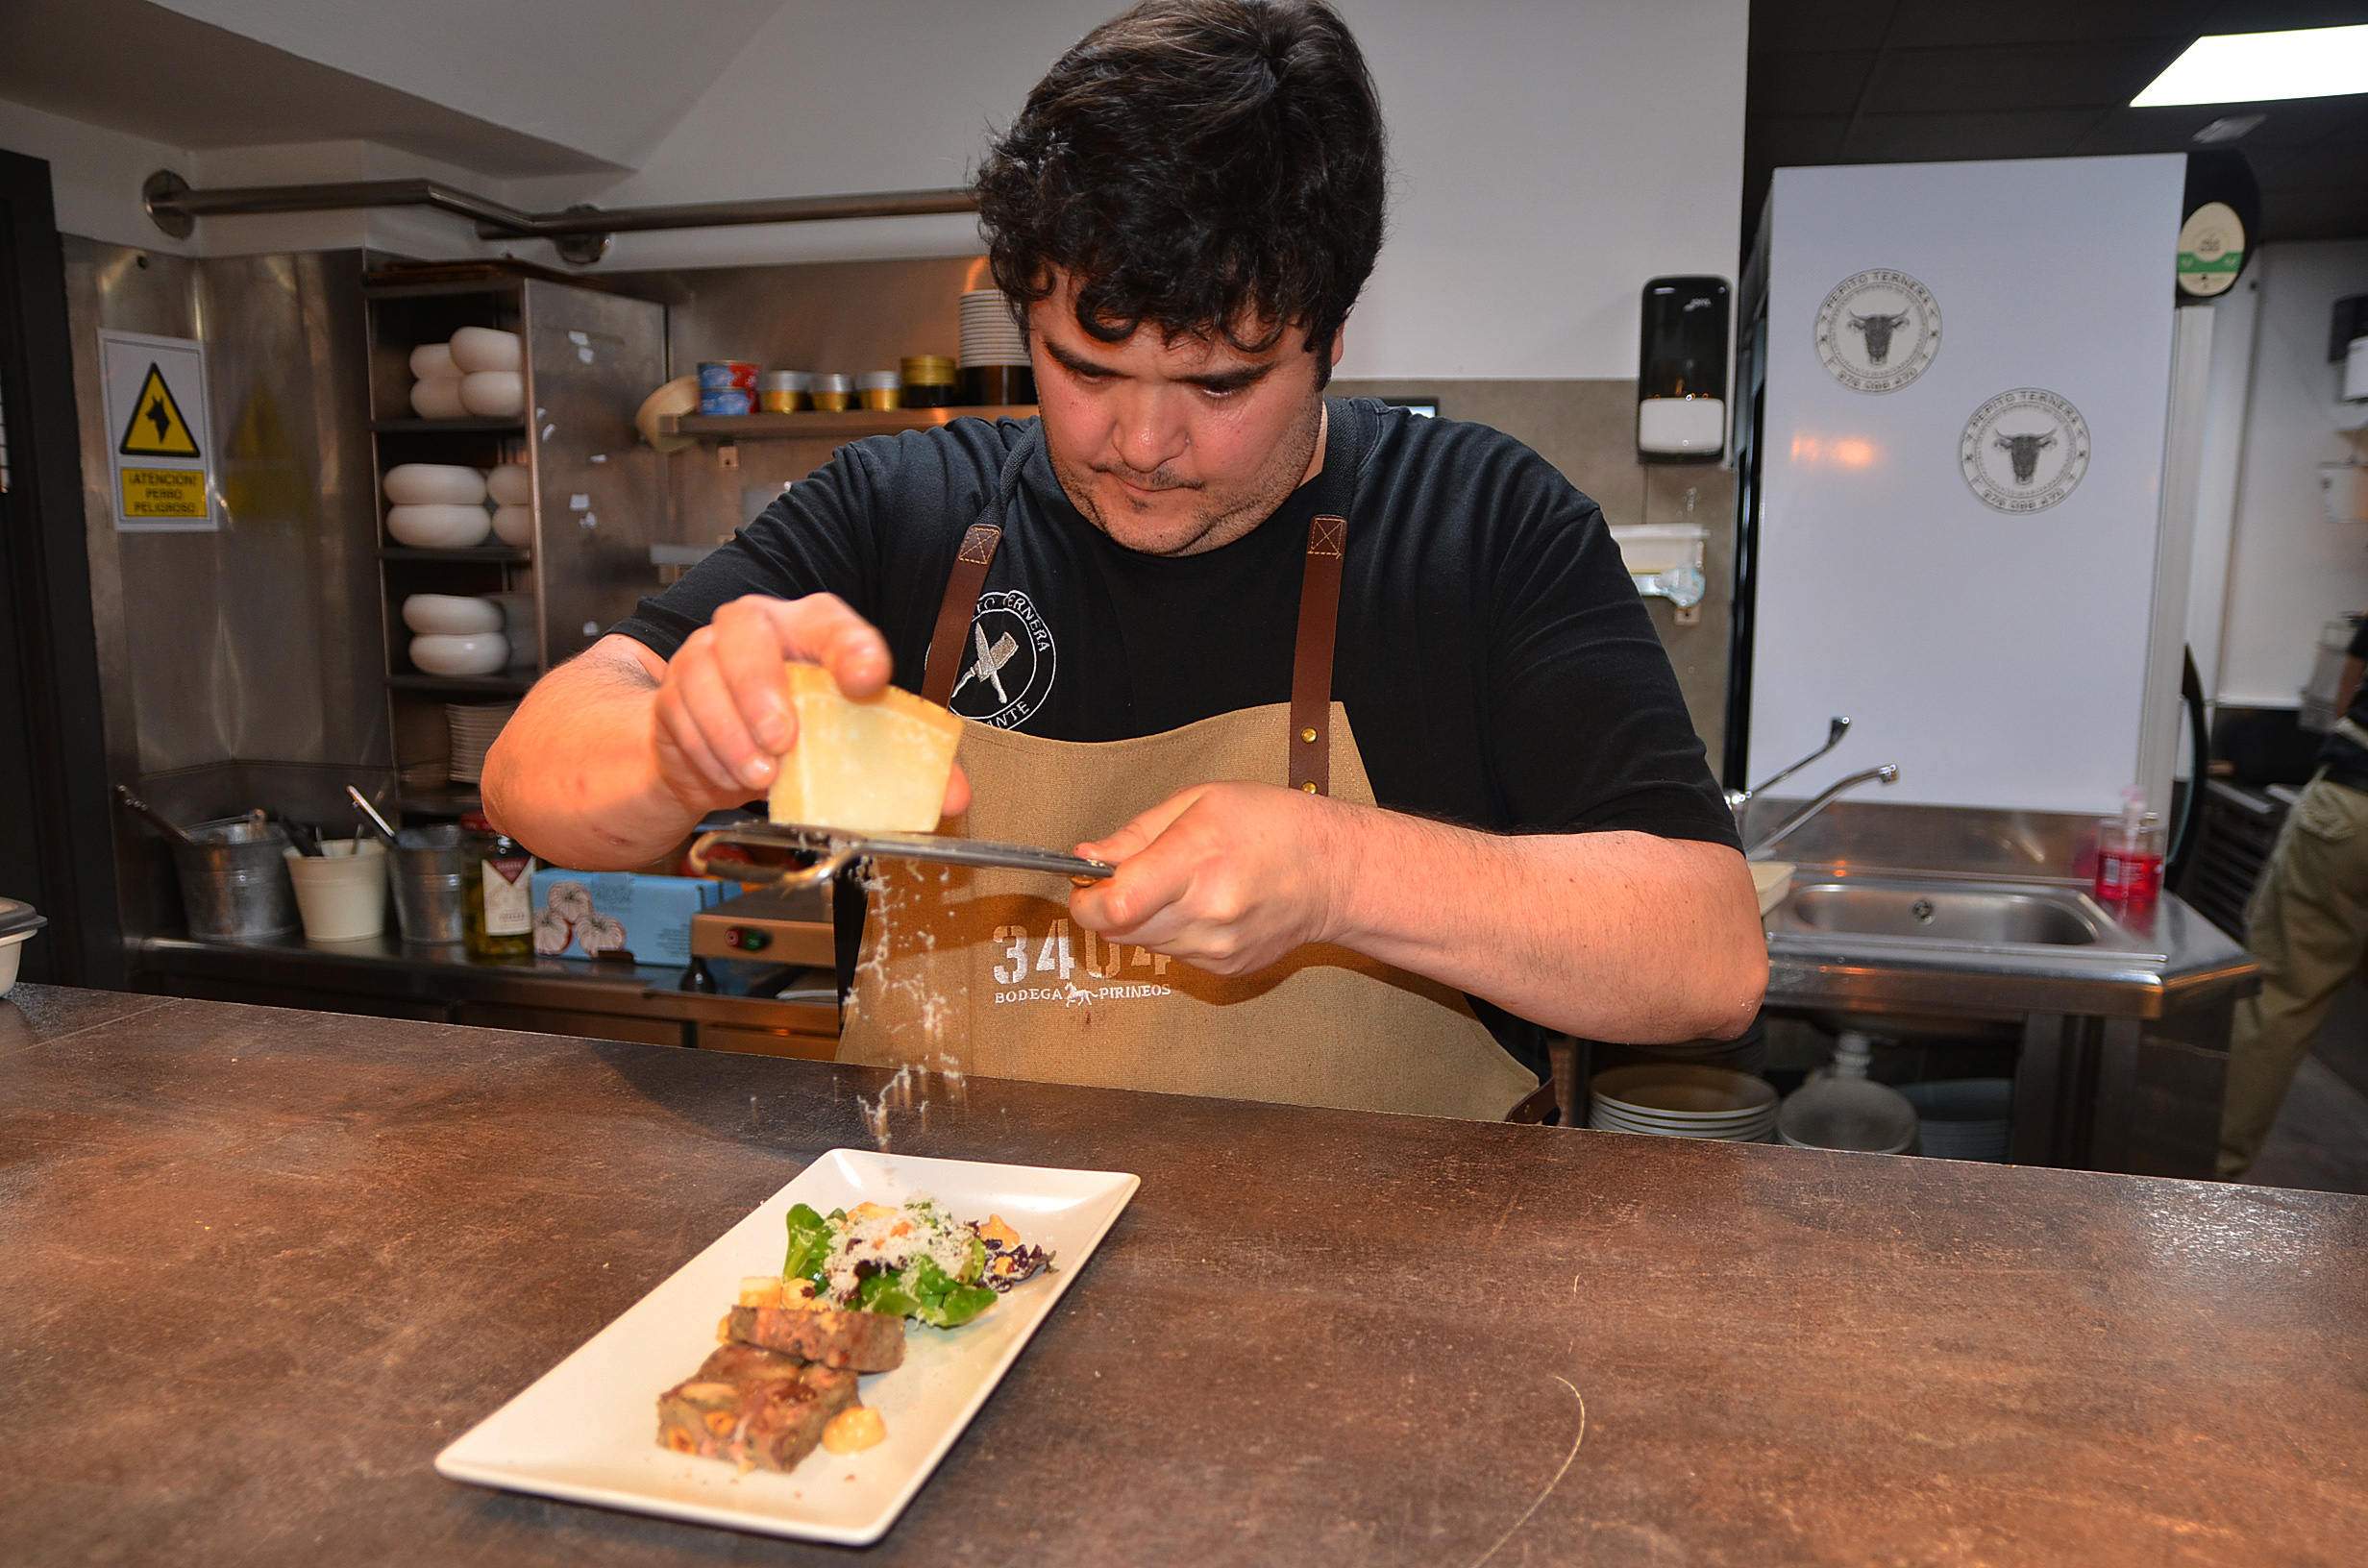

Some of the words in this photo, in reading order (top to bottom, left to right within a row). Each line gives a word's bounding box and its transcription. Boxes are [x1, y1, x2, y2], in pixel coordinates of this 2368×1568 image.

[1827, 273, 1868, 308] PEPITO
[1872, 271, 1932, 306] TERNERA
[1971, 392, 2015, 428] PEPITO
[2019, 390, 2079, 425] TERNERA
[145, 487, 183, 500] PERRO
[134, 502, 196, 514] PELIGROSO
[994, 988, 1064, 1004] BODEGA
[1098, 983, 1172, 1000] PIRINEOS
